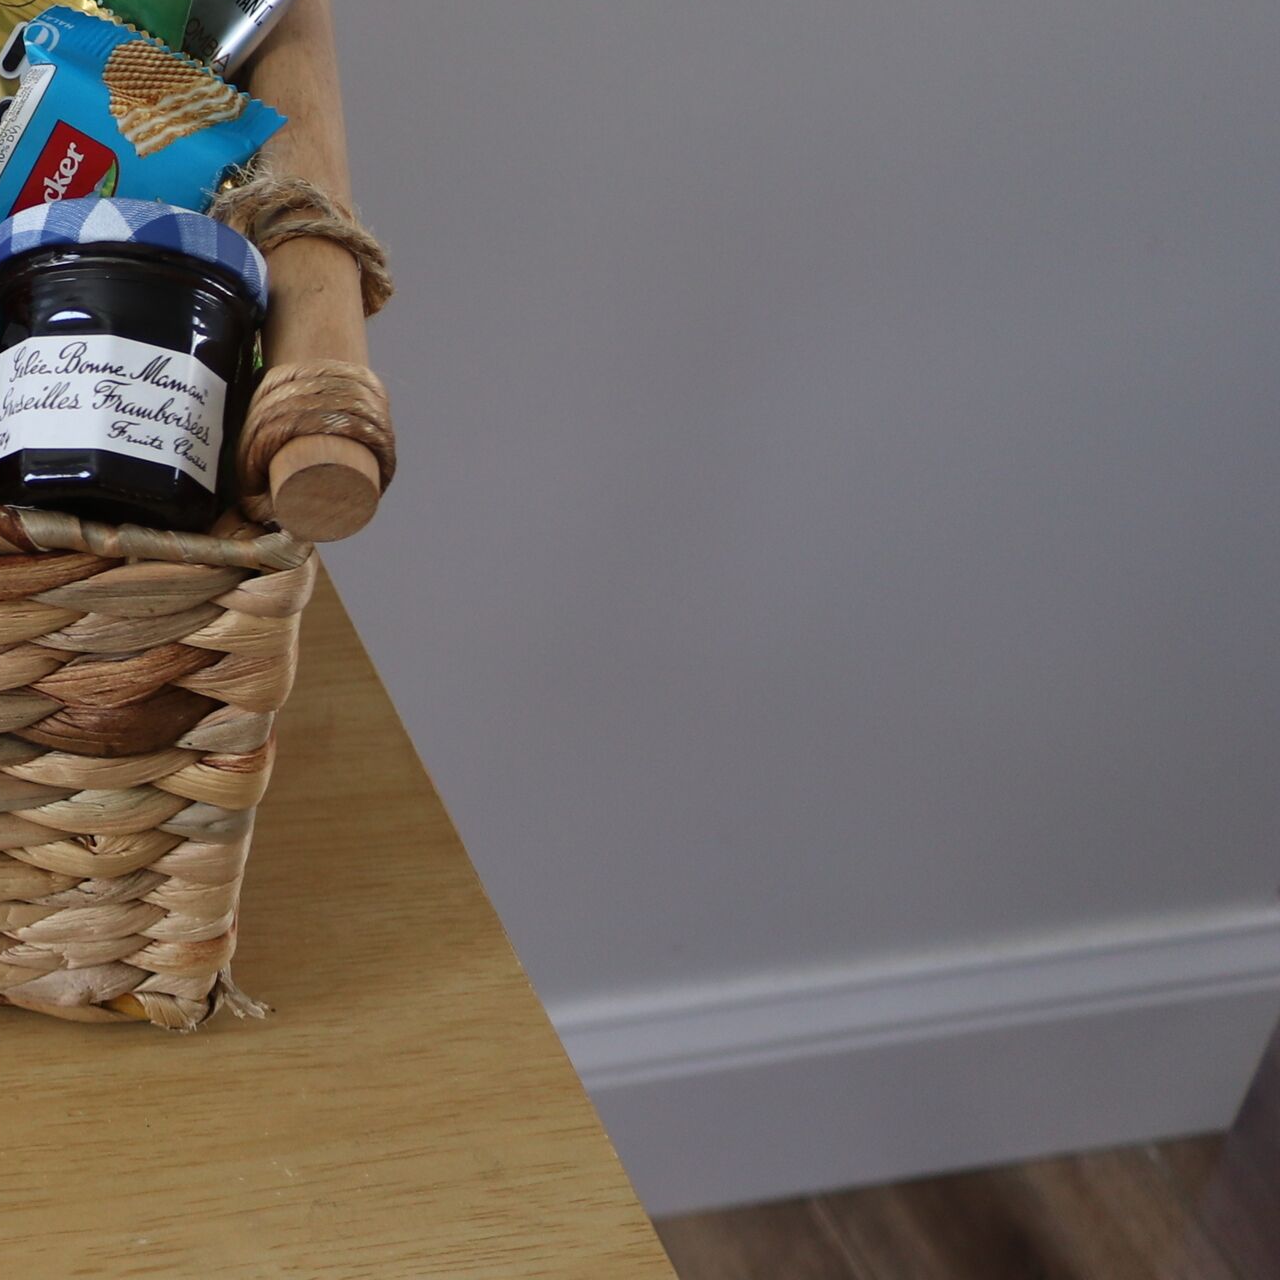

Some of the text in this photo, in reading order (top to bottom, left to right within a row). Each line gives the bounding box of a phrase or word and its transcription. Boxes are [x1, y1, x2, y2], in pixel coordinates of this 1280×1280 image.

[185, 17, 232, 72] OMBIA
[44, 141, 85, 204] cker
[55, 340, 127, 376] Bonne
[130, 355, 206, 405] Maman
[107, 419, 164, 451] Fruits
